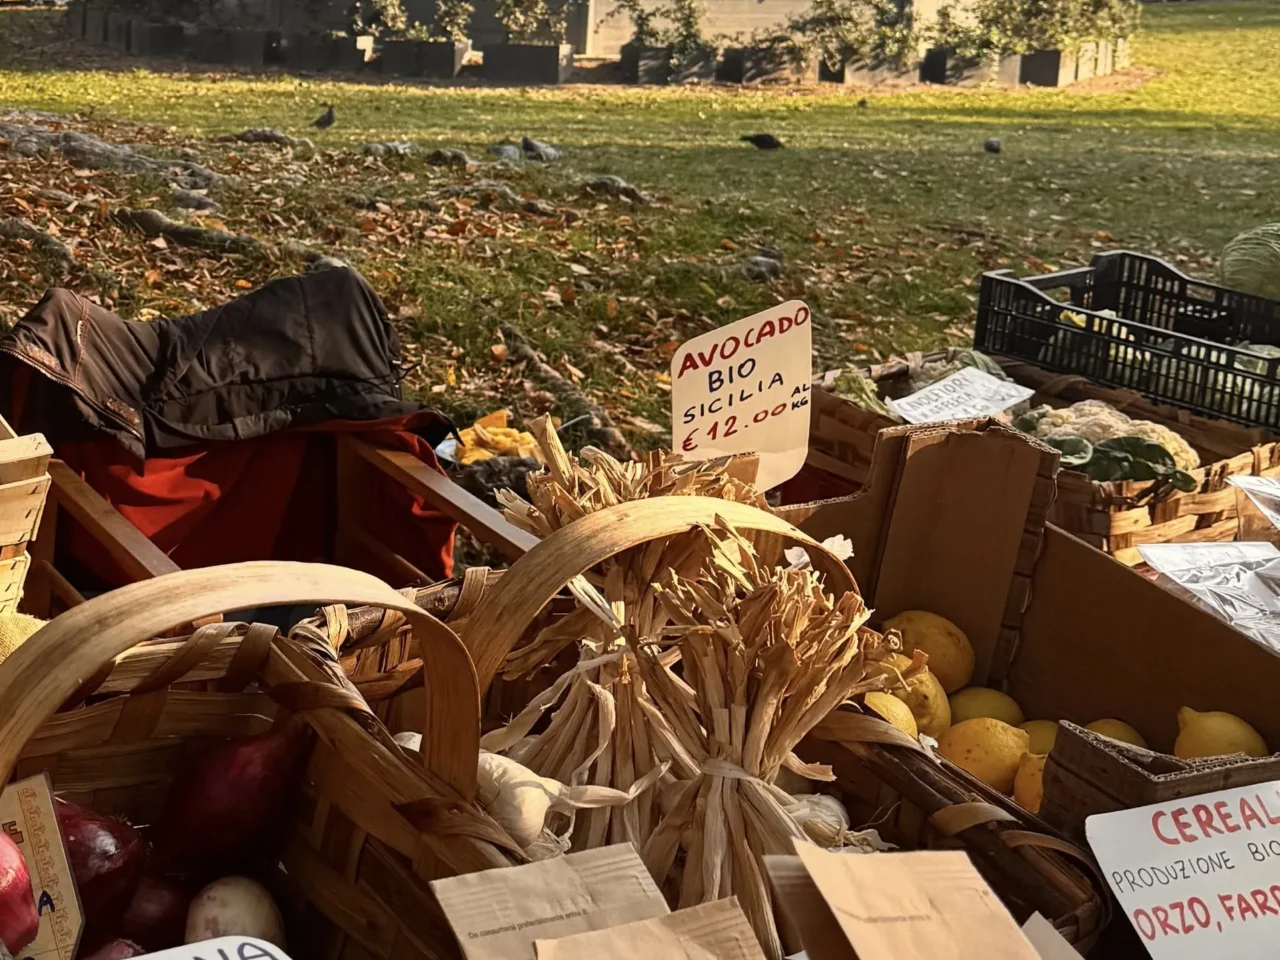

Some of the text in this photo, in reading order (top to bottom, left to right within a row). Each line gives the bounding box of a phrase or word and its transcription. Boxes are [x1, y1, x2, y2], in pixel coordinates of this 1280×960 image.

[677, 306, 809, 379] AVOCADO
[683, 372, 784, 424] SICILIA
[708, 358, 756, 393] BIO
[791, 384, 810, 397] AL
[791, 396, 809, 411] KG
[682, 403, 787, 452] € 12.00
[1151, 791, 1280, 845] CEREAL
[1111, 851, 1235, 893] PRODUZIONE
